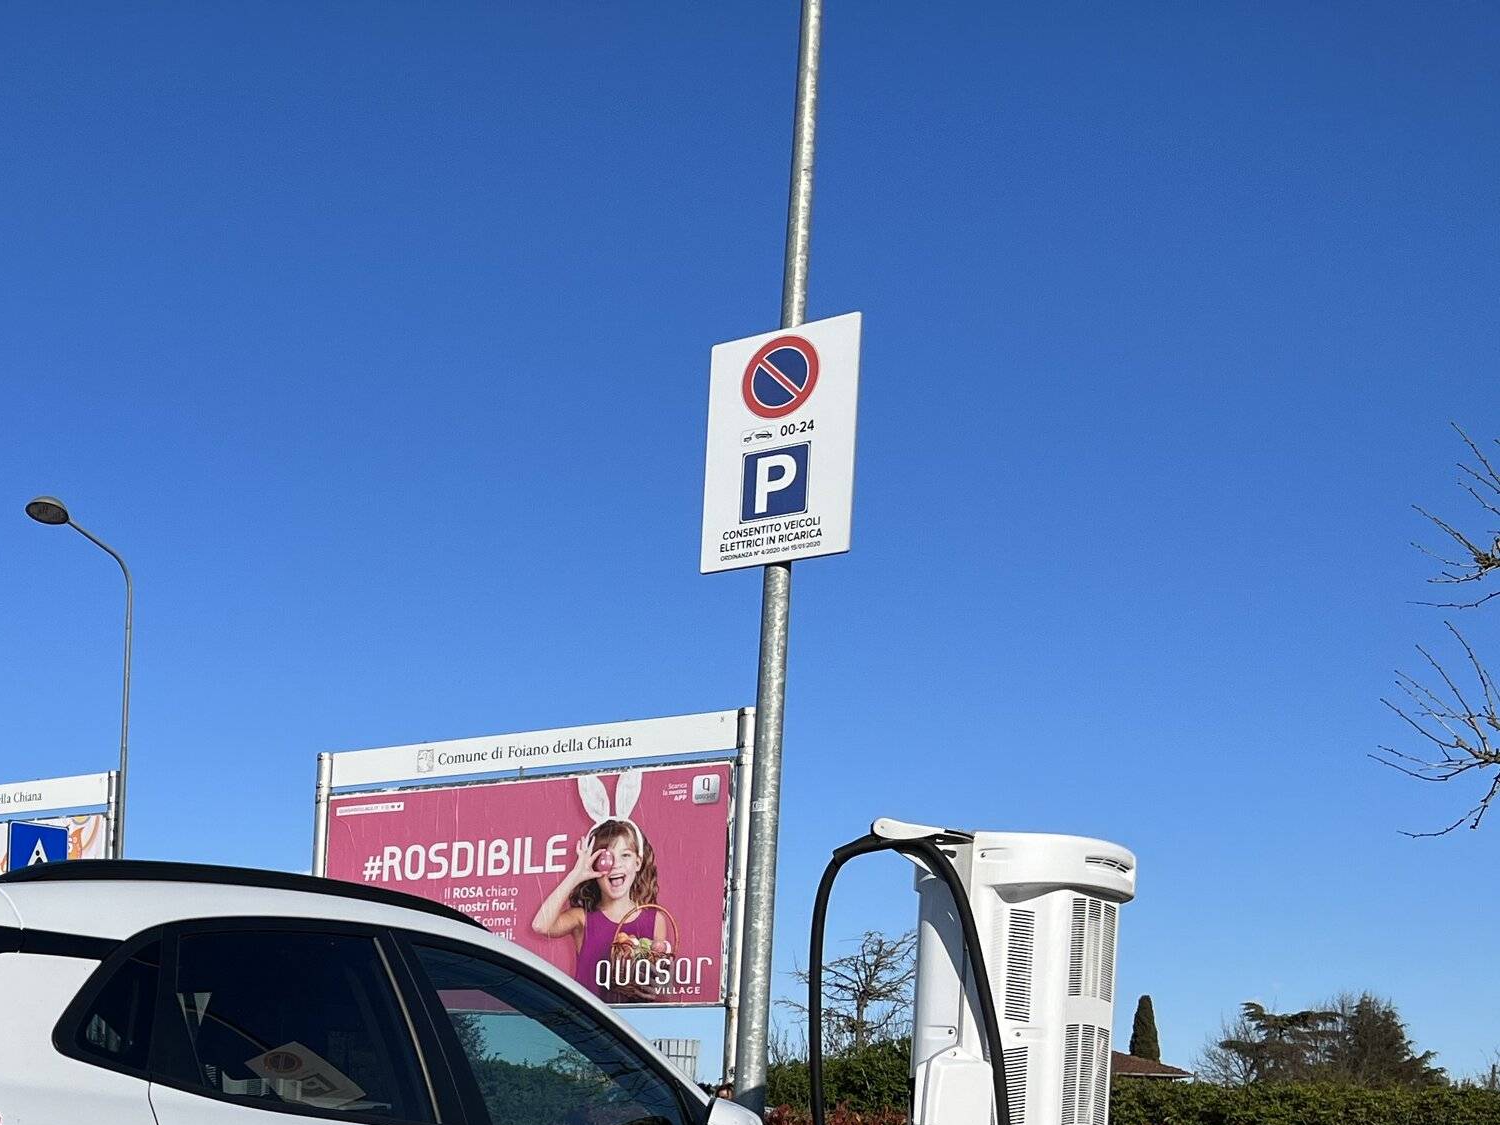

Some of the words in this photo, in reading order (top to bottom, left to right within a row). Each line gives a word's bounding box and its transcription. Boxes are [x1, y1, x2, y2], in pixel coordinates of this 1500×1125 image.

[781, 420, 814, 436] 00-24
[754, 454, 797, 514] P
[722, 523, 781, 540] CONSENTITO
[784, 516, 820, 530] VEICOLI
[720, 538, 764, 552] ELETTRICI
[766, 536, 775, 545] IN
[779, 528, 822, 543] RICARICA
[720, 552, 752, 561] ORDINANZA
[438, 752, 487, 765] Comune
[491, 746, 503, 760] di
[508, 745, 549, 758] Foiano
[552, 739, 582, 754] della
[587, 736, 632, 749] Chiana
[13, 792, 42, 802] Chiana
[362, 834, 568, 882] #ROSDIBILE
[444, 887, 451, 899] Il
[452, 886, 483, 898] ROSA
[485, 885, 519, 897] chiaro
[458, 900, 489, 912] nostri
[492, 899, 517, 911] fiori,
[482, 917, 511, 926] come
